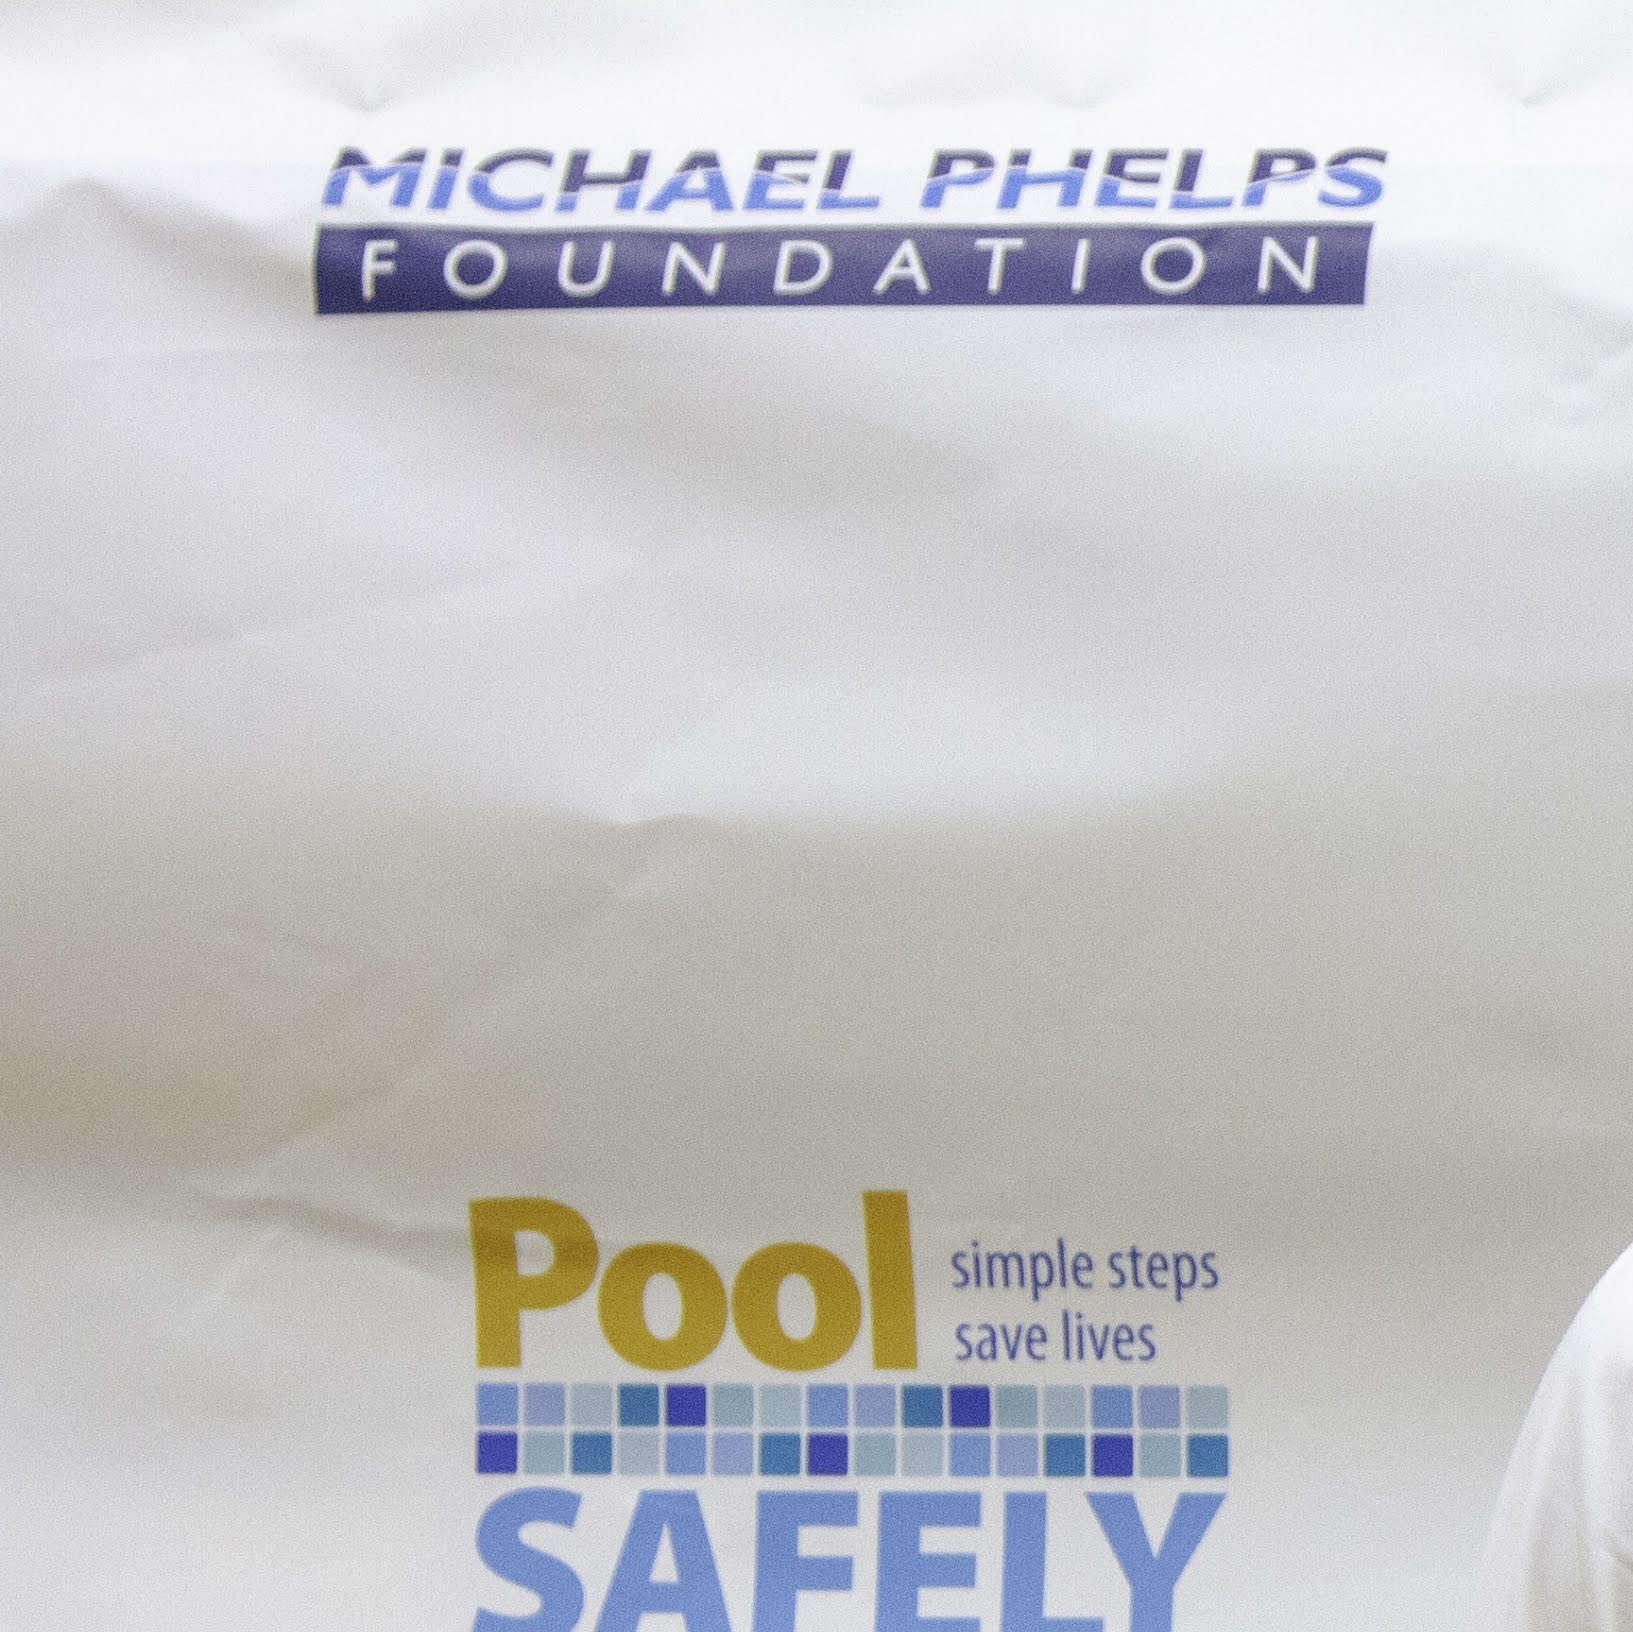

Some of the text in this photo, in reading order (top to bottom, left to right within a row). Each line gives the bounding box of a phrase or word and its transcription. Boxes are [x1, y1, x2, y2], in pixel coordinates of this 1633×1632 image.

[321, 148, 1388, 214] MICHAEL PHELPS
[362, 236, 1320, 299] FOUNDATION
[468, 1190, 918, 1372] Pool
[950, 1238, 1220, 1302] simple steps
[955, 1309, 1158, 1362] save lives
